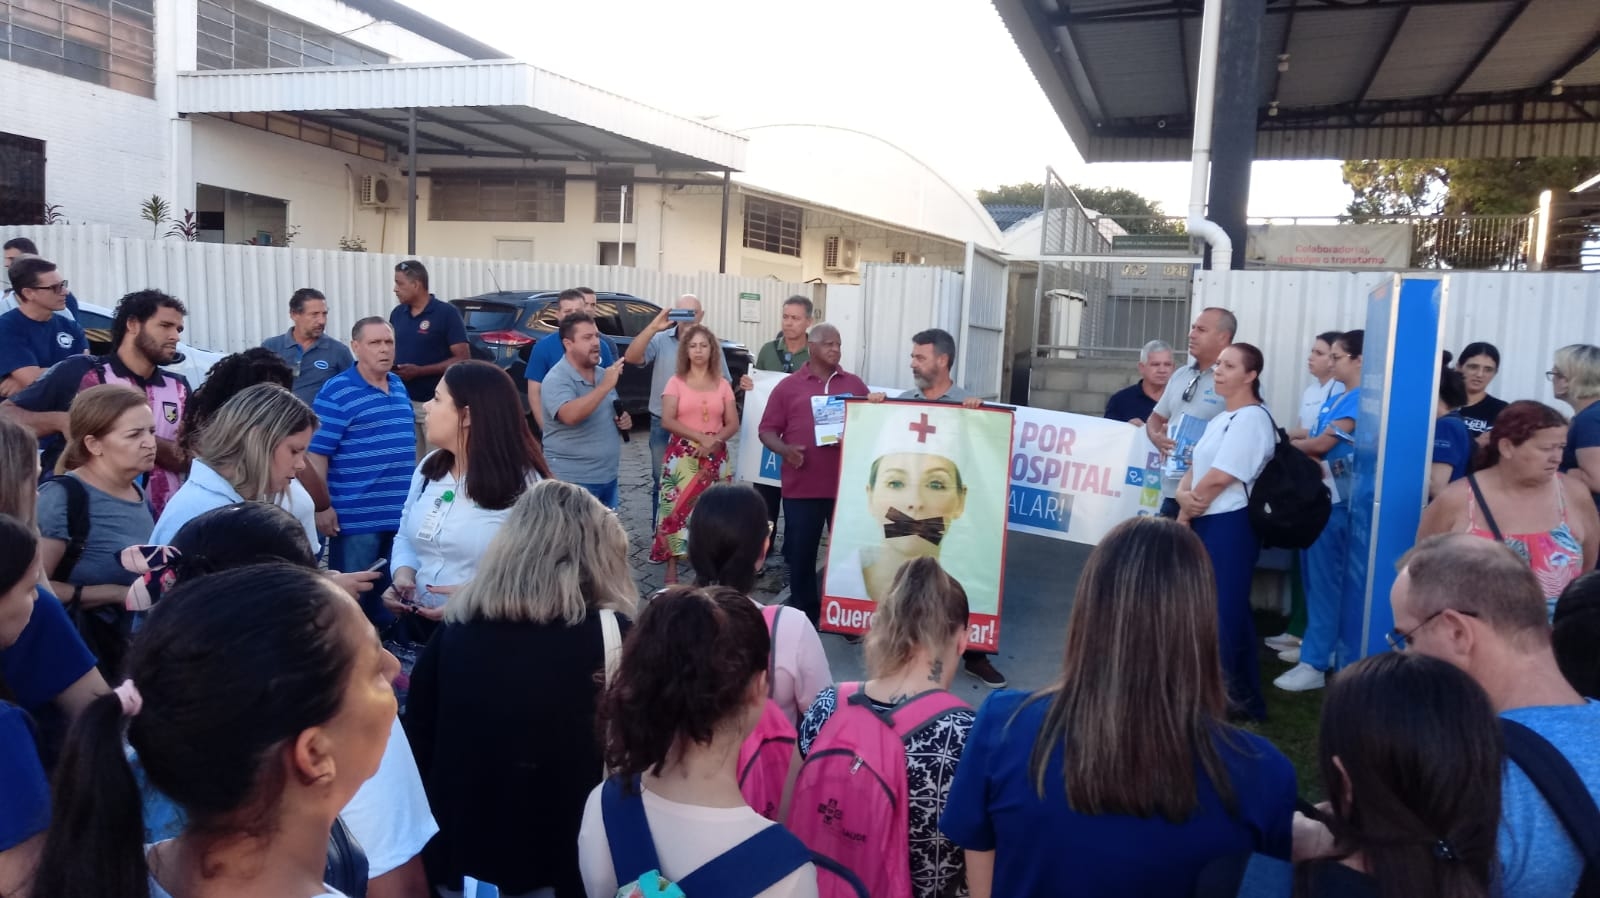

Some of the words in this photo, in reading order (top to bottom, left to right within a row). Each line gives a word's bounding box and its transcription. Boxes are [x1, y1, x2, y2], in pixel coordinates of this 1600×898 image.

[1019, 421, 1076, 456] POR
[1010, 453, 1121, 498] OSPITAL.
[1008, 490, 1065, 522] ALAR!
[969, 619, 995, 645] ar!
